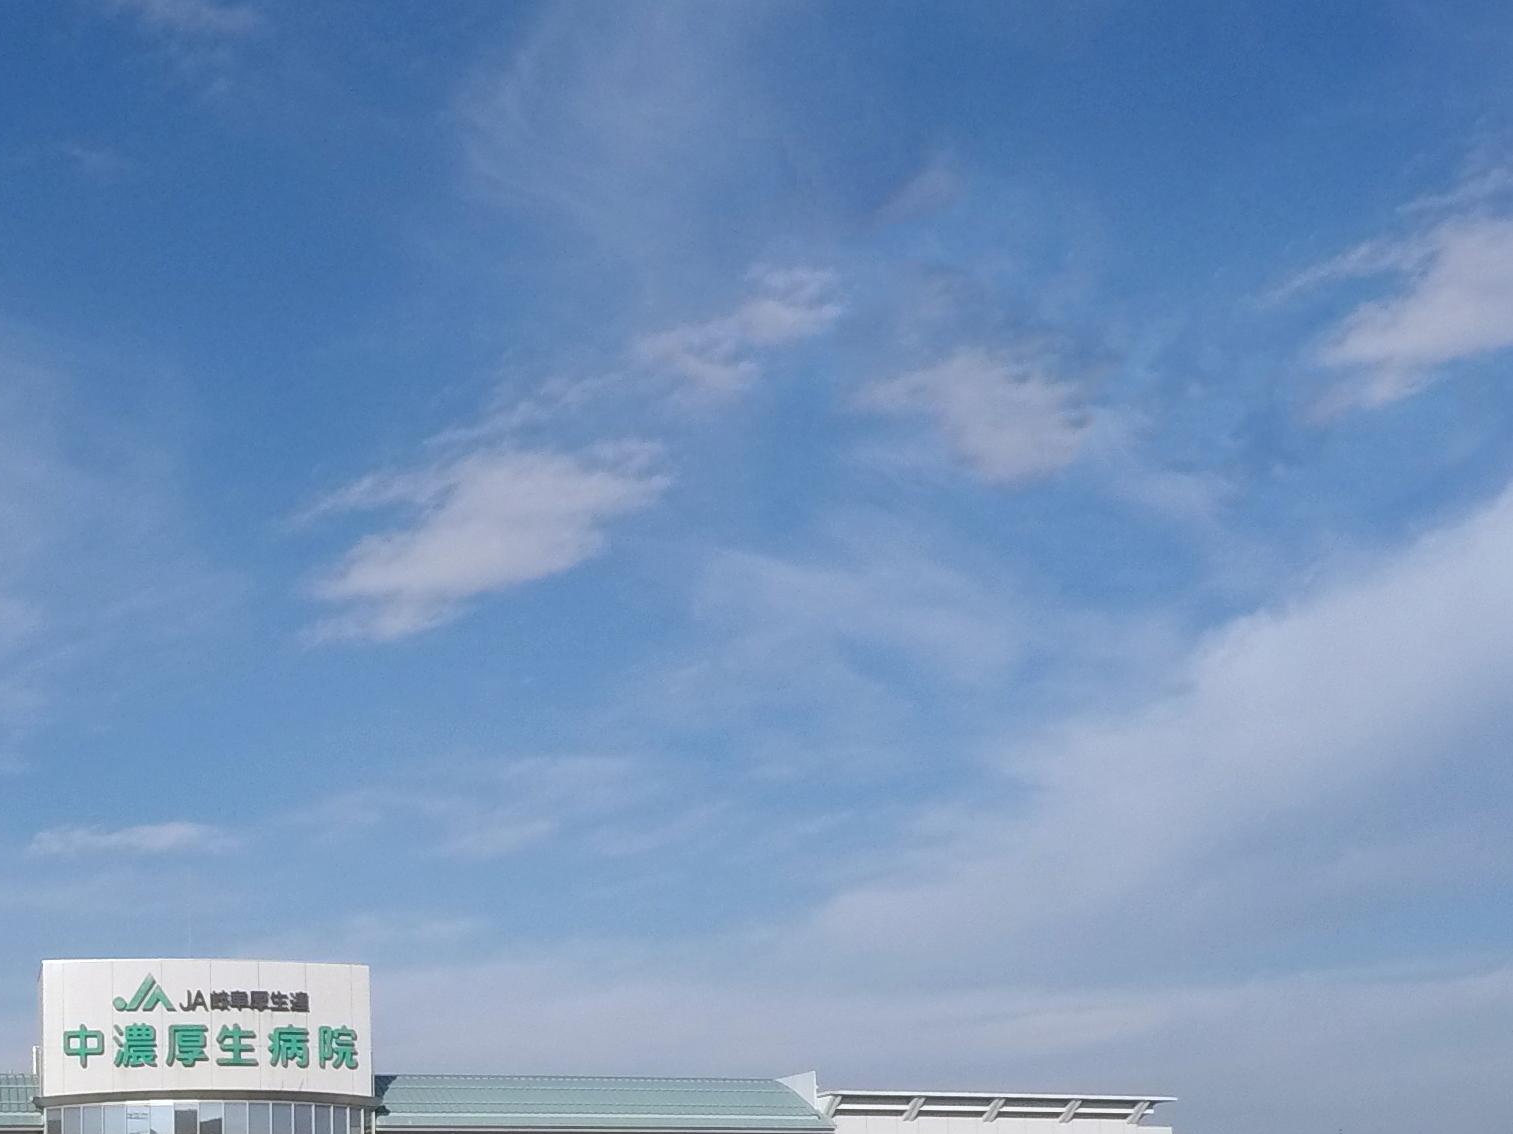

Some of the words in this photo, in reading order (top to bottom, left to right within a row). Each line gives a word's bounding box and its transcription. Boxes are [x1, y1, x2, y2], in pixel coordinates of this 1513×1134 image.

[63, 1023, 359, 1069] 中濃厚生病院
